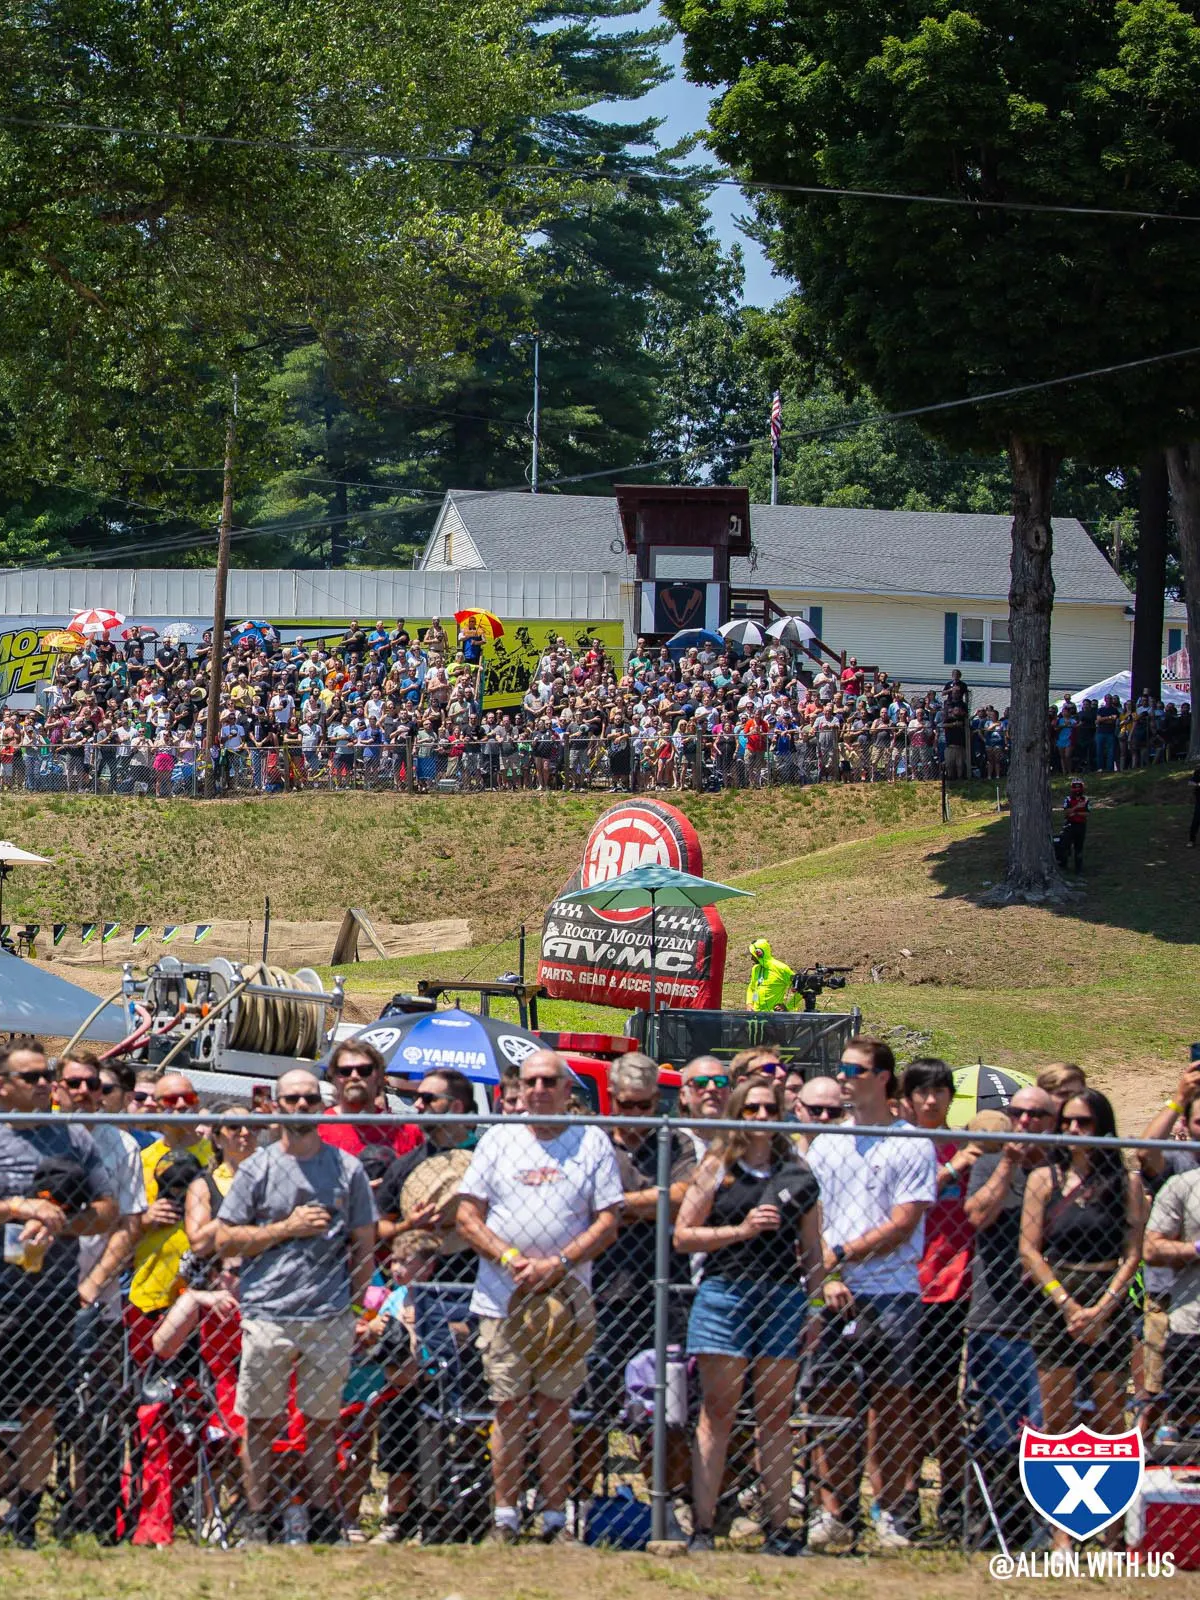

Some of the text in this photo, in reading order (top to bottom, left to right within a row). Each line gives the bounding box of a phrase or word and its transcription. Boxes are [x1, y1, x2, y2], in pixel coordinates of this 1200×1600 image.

[561, 922, 696, 952] ROCKY MOUNTAIN
[541, 966, 576, 984] PARTS,
[579, 971, 606, 985] GEAR
[609, 976, 617, 988] &
[422, 1048, 486, 1066] YAMAHA
